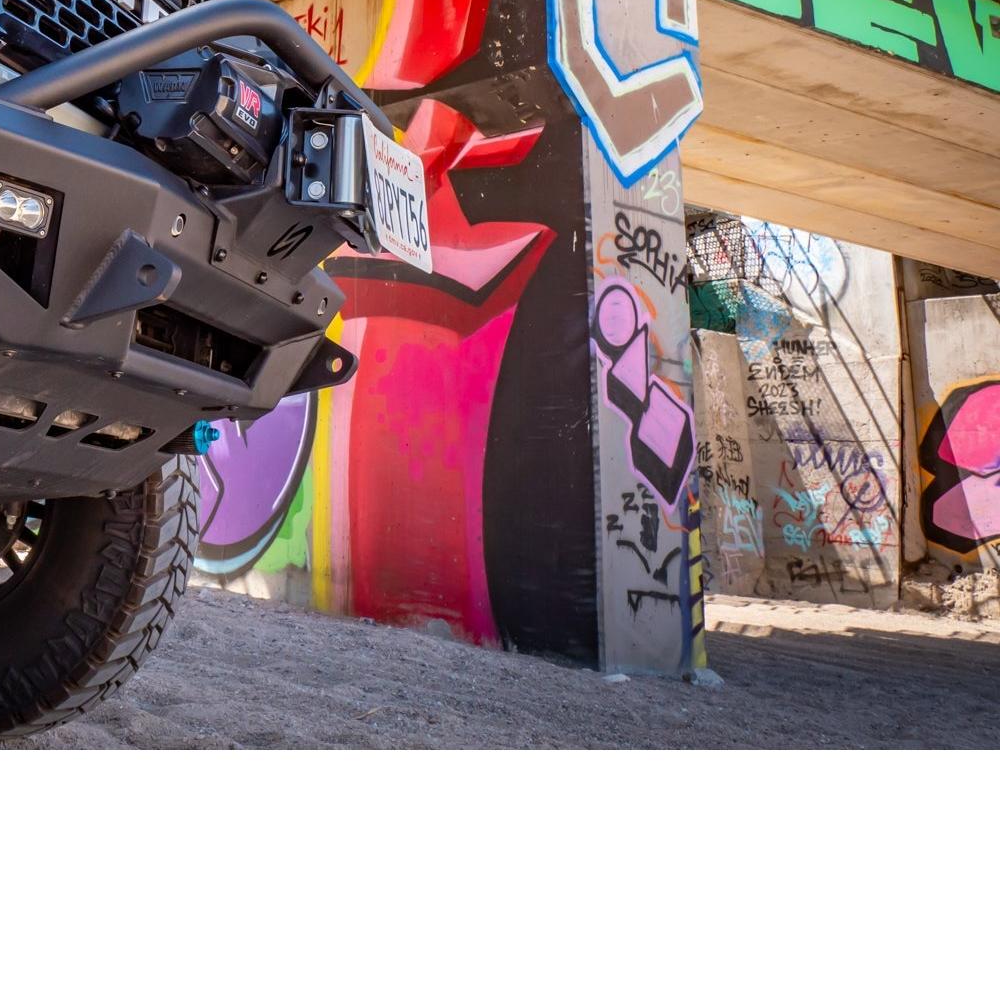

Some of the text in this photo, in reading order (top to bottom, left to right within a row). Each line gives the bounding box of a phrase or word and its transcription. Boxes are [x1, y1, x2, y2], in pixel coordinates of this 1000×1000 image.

[238, 109, 257, 128] EVO
[240, 79, 262, 119] VR
[372, 134, 408, 176] California
